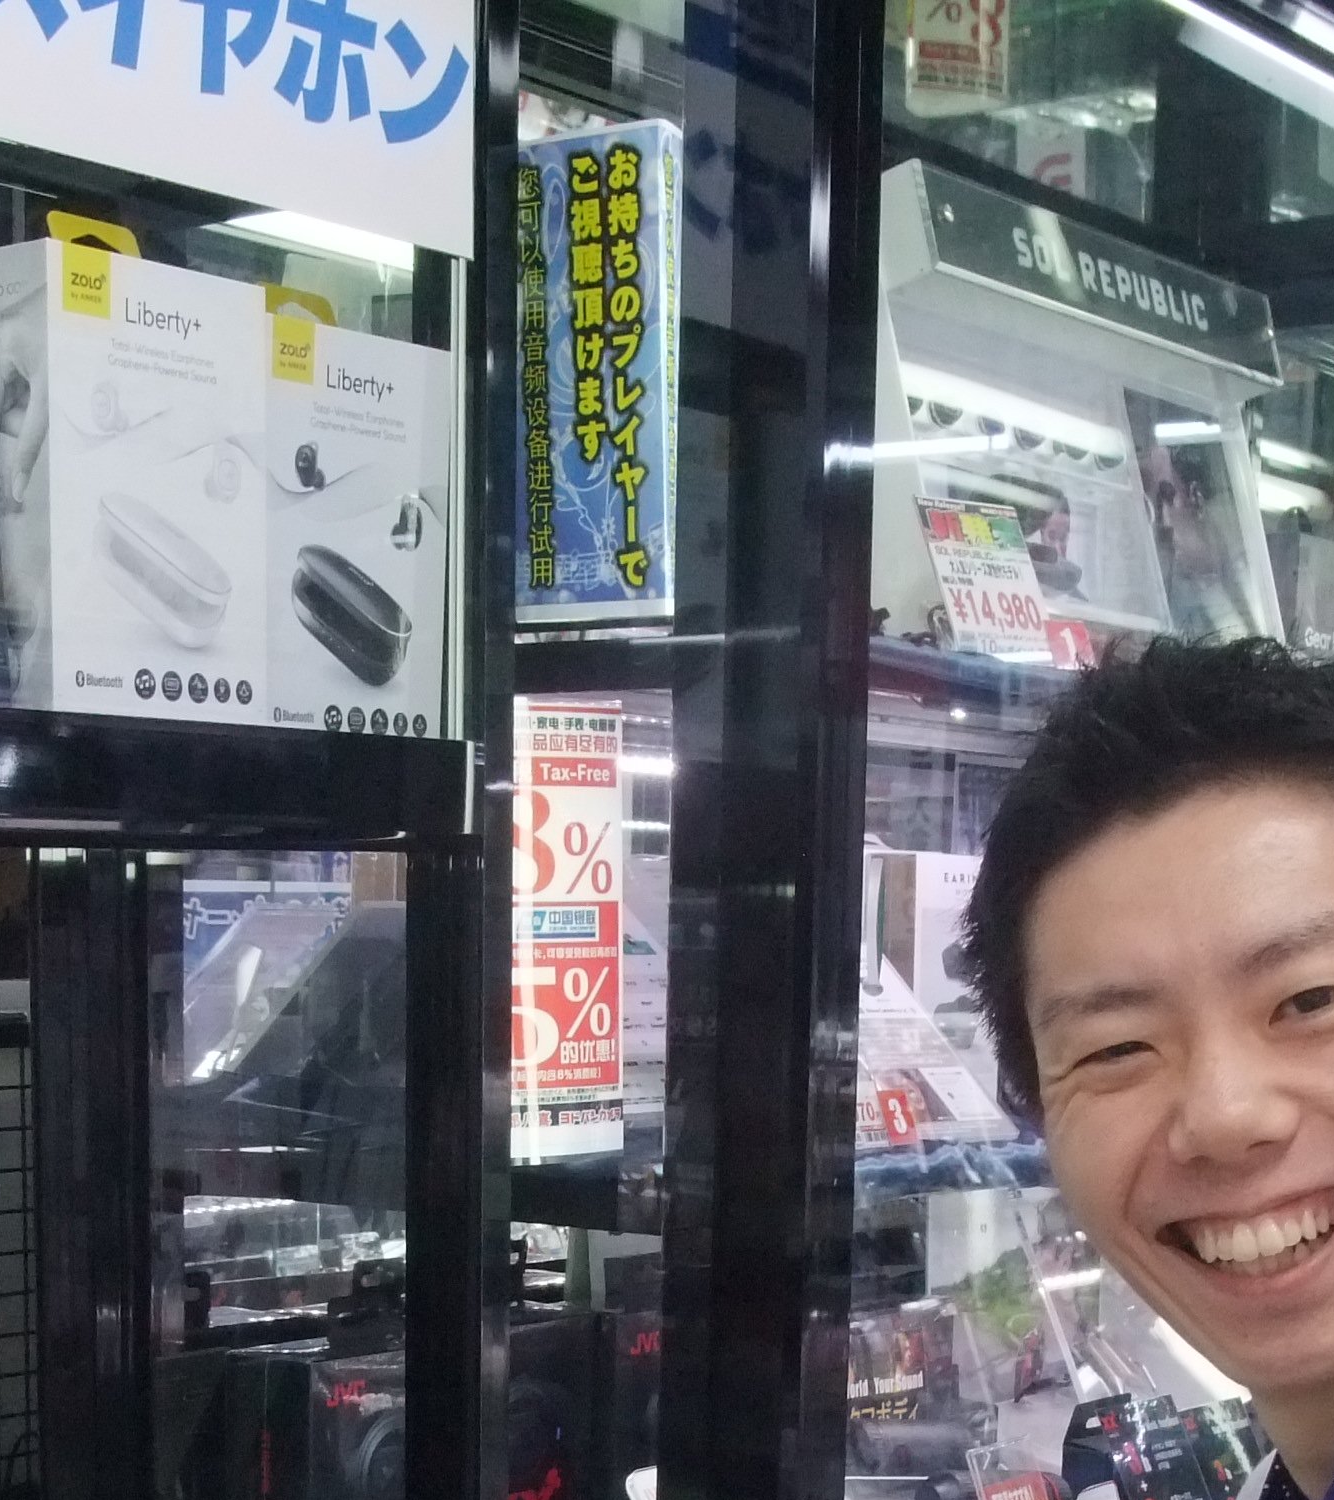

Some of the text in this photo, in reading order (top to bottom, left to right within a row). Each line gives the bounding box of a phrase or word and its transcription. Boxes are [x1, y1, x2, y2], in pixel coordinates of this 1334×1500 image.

[70, 272, 103, 292] ZOLO
[1077, 250, 1210, 332] REPUBLIC
[125, 298, 202, 340] Liberty+
[569, 154, 607, 463] ご視聴頂けます
[279, 342, 308, 359] ZOLO
[607, 146, 648, 588] お持ちのプレイヤーで
[326, 365, 395, 402] Liberty+
[948, 586, 1043, 633] ¥14,980
[1304, 625, 1330, 649] Gear
[86, 673, 124, 690] Bluetooth
[539, 762, 611, 782] Tax-Free
[889, 1096, 909, 1137] 3
